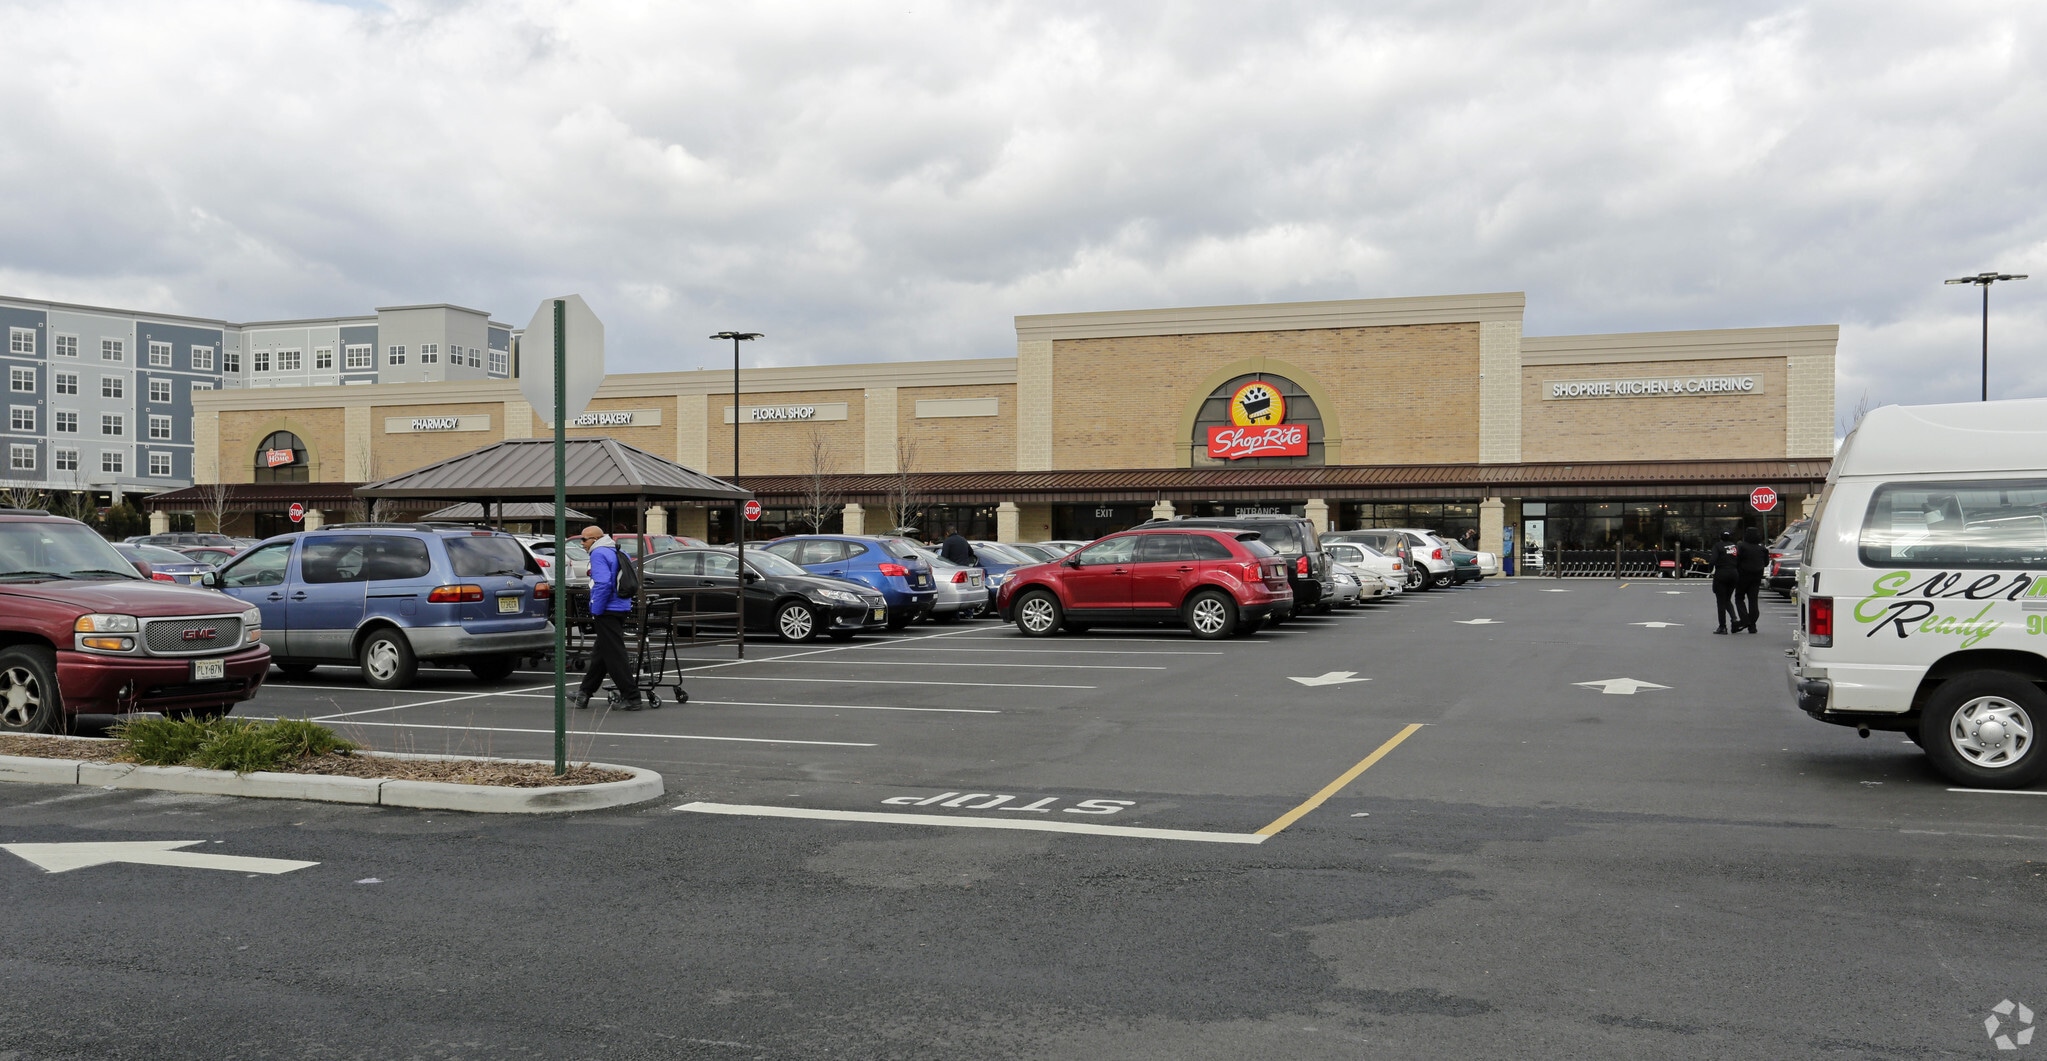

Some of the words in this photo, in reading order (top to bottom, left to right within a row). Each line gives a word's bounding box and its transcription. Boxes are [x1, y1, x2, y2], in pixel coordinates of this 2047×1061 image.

[1552, 381, 1611, 397] SHOPRITE
[1614, 379, 1669, 395] KITCHEN
[1672, 379, 1684, 393] &
[1686, 377, 1754, 393] CATERING
[600, 412, 632, 424] BAKERY
[751, 407, 787, 420] FLORAL
[788, 406, 815, 419] SHOP
[411, 417, 459, 430] PHARMACY
[1213, 426, 1302, 455] ShopRite
[1752, 494, 1775, 505] STOP
[290, 508, 303, 517] STOP
[745, 506, 760, 515] STOP
[1095, 508, 1114, 518] EXIT
[1234, 507, 1280, 516] ENTRANCE
[1811, 571, 1821, 593] 1
[1866, 600, 2004, 649] Ready
[2026, 614, 2047, 636] 9
[183, 628, 217, 640] GMC
[881, 792, 1136, 815] STOP
